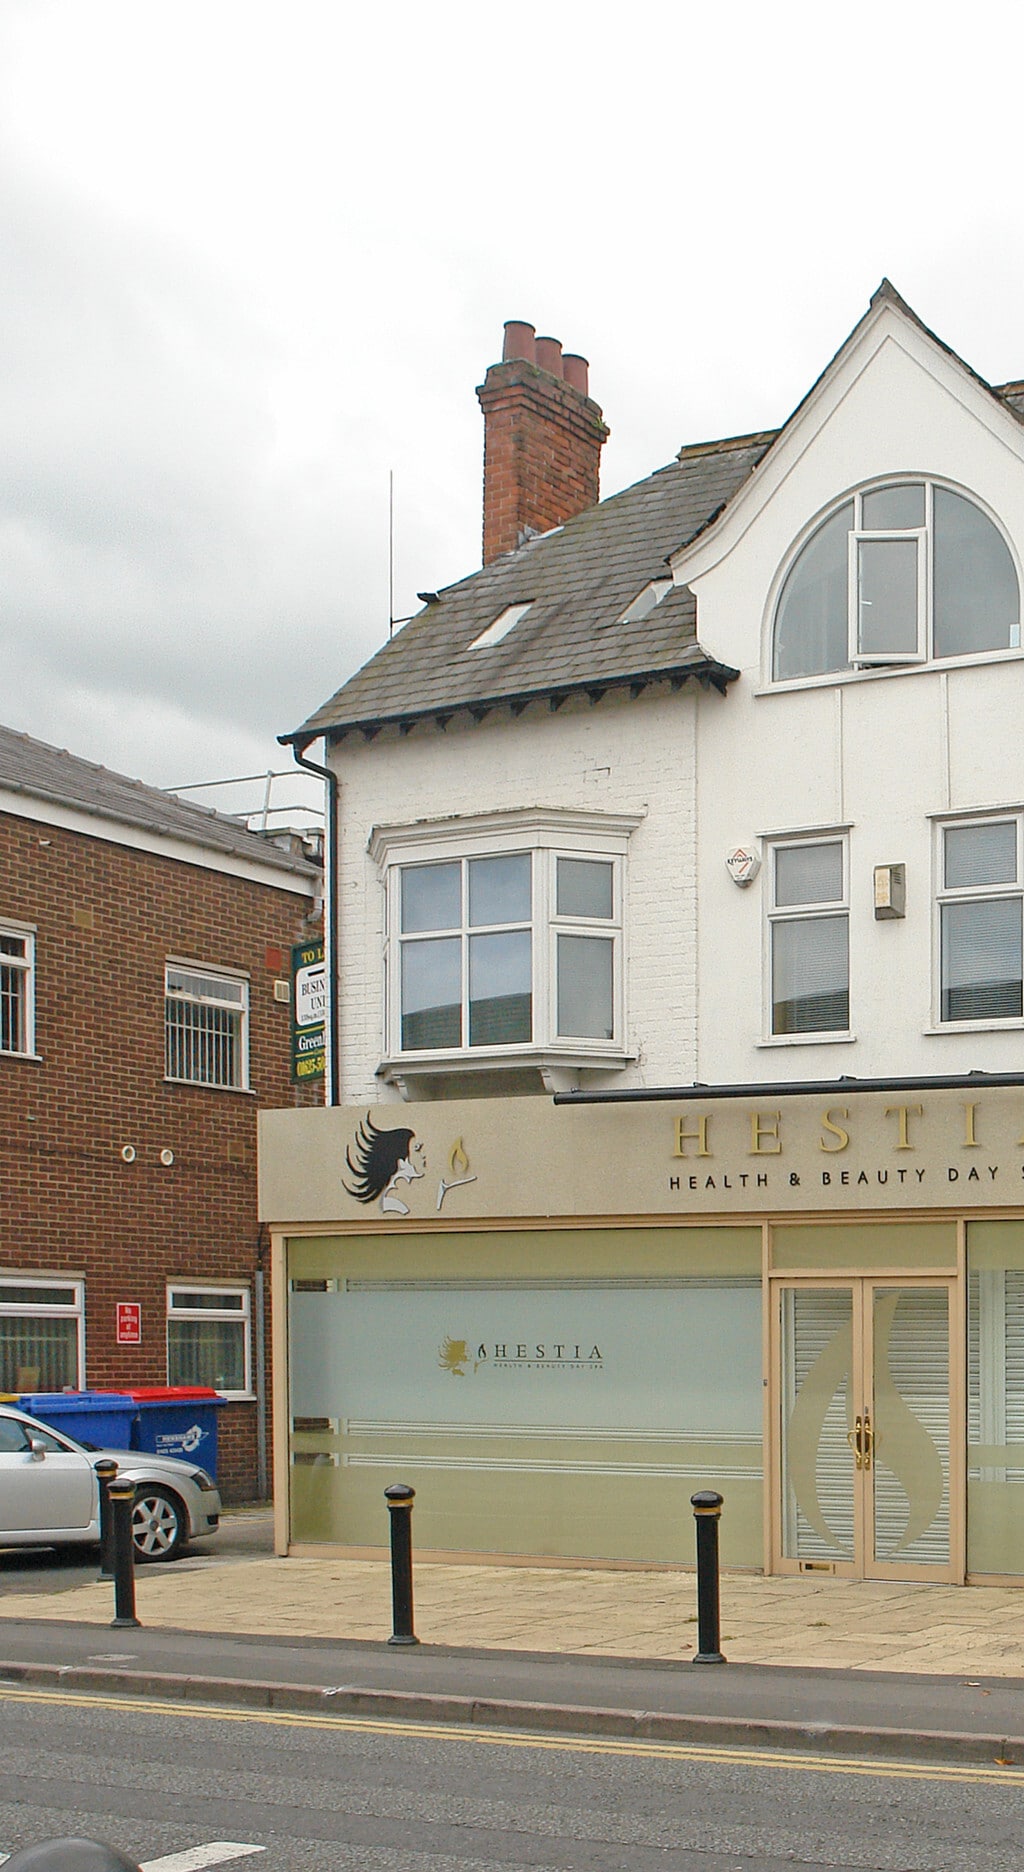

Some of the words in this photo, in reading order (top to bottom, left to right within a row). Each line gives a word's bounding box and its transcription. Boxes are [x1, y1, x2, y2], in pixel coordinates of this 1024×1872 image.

[302, 950, 315, 963] TO
[669, 1173, 768, 1190] HEALTH
[789, 1172, 801, 1186] &
[822, 1168, 926, 1185] BEAUTY
[948, 1166, 999, 1181] DAY
[495, 1344, 603, 1359] HESTIA
